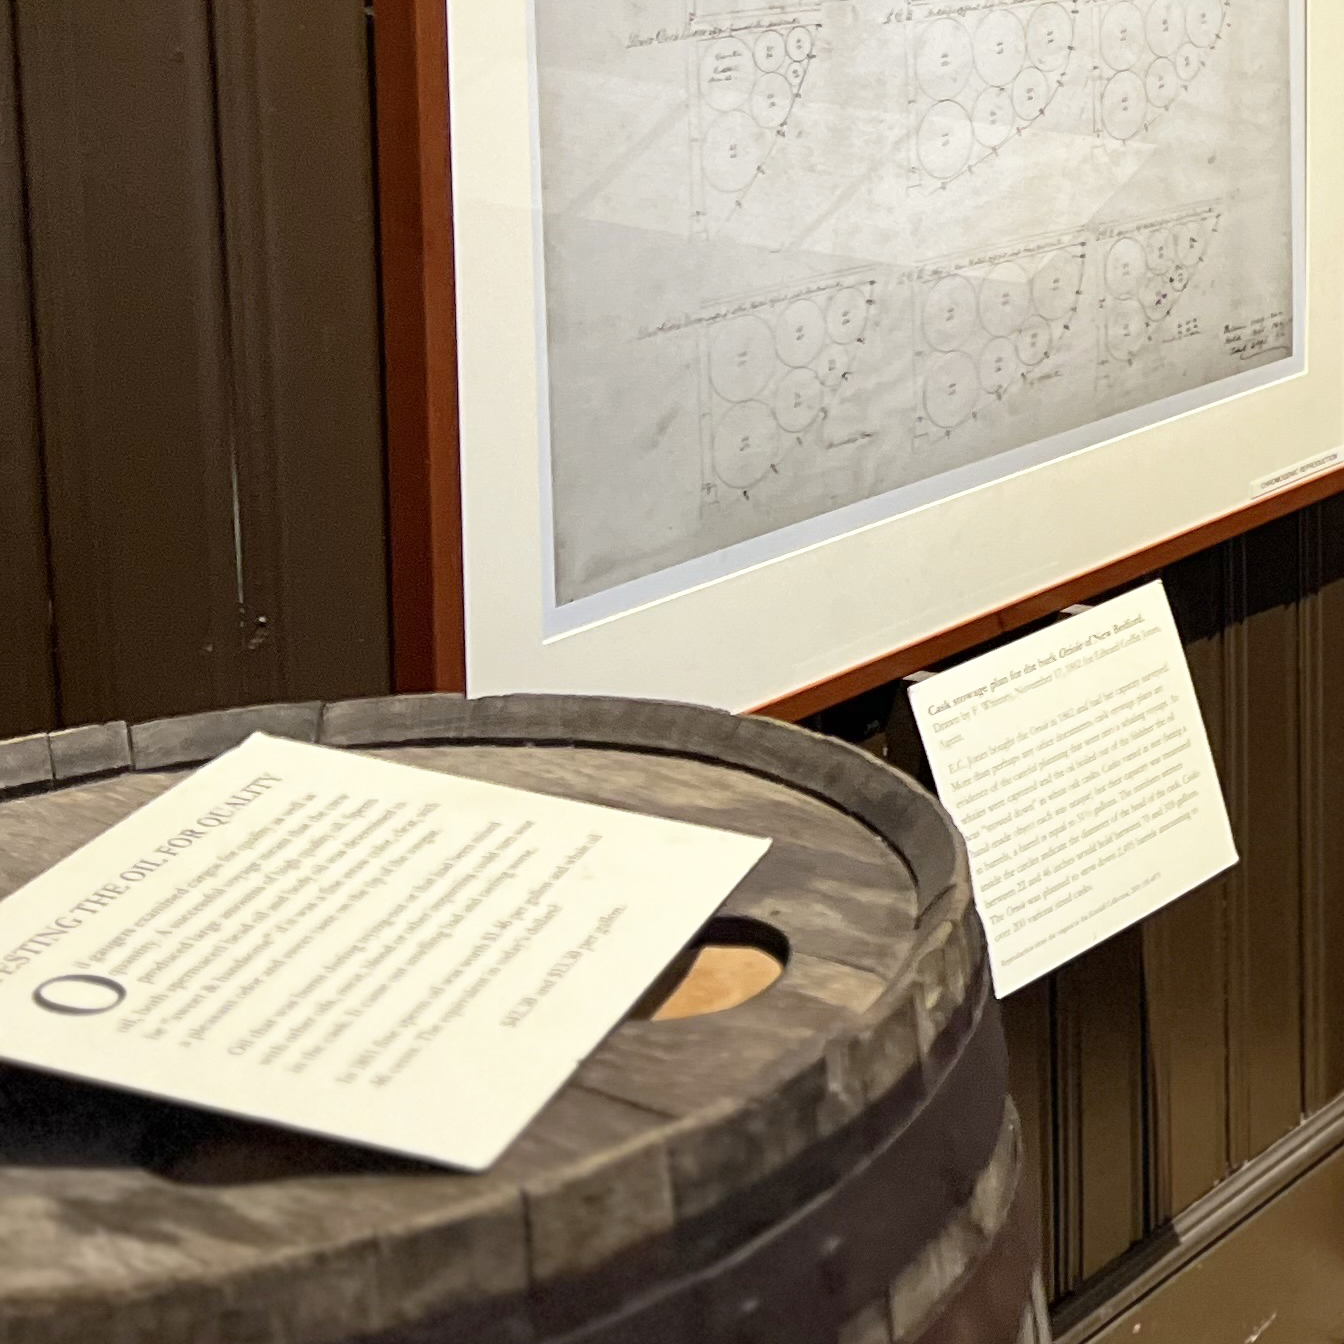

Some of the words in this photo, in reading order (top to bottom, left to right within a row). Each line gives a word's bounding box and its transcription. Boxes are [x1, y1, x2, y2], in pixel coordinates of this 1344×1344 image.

[69, 883, 130, 913] THE
[119, 858, 168, 881] OIL
[154, 828, 206, 856] FOR
[196, 773, 281, 827] QUALITY
